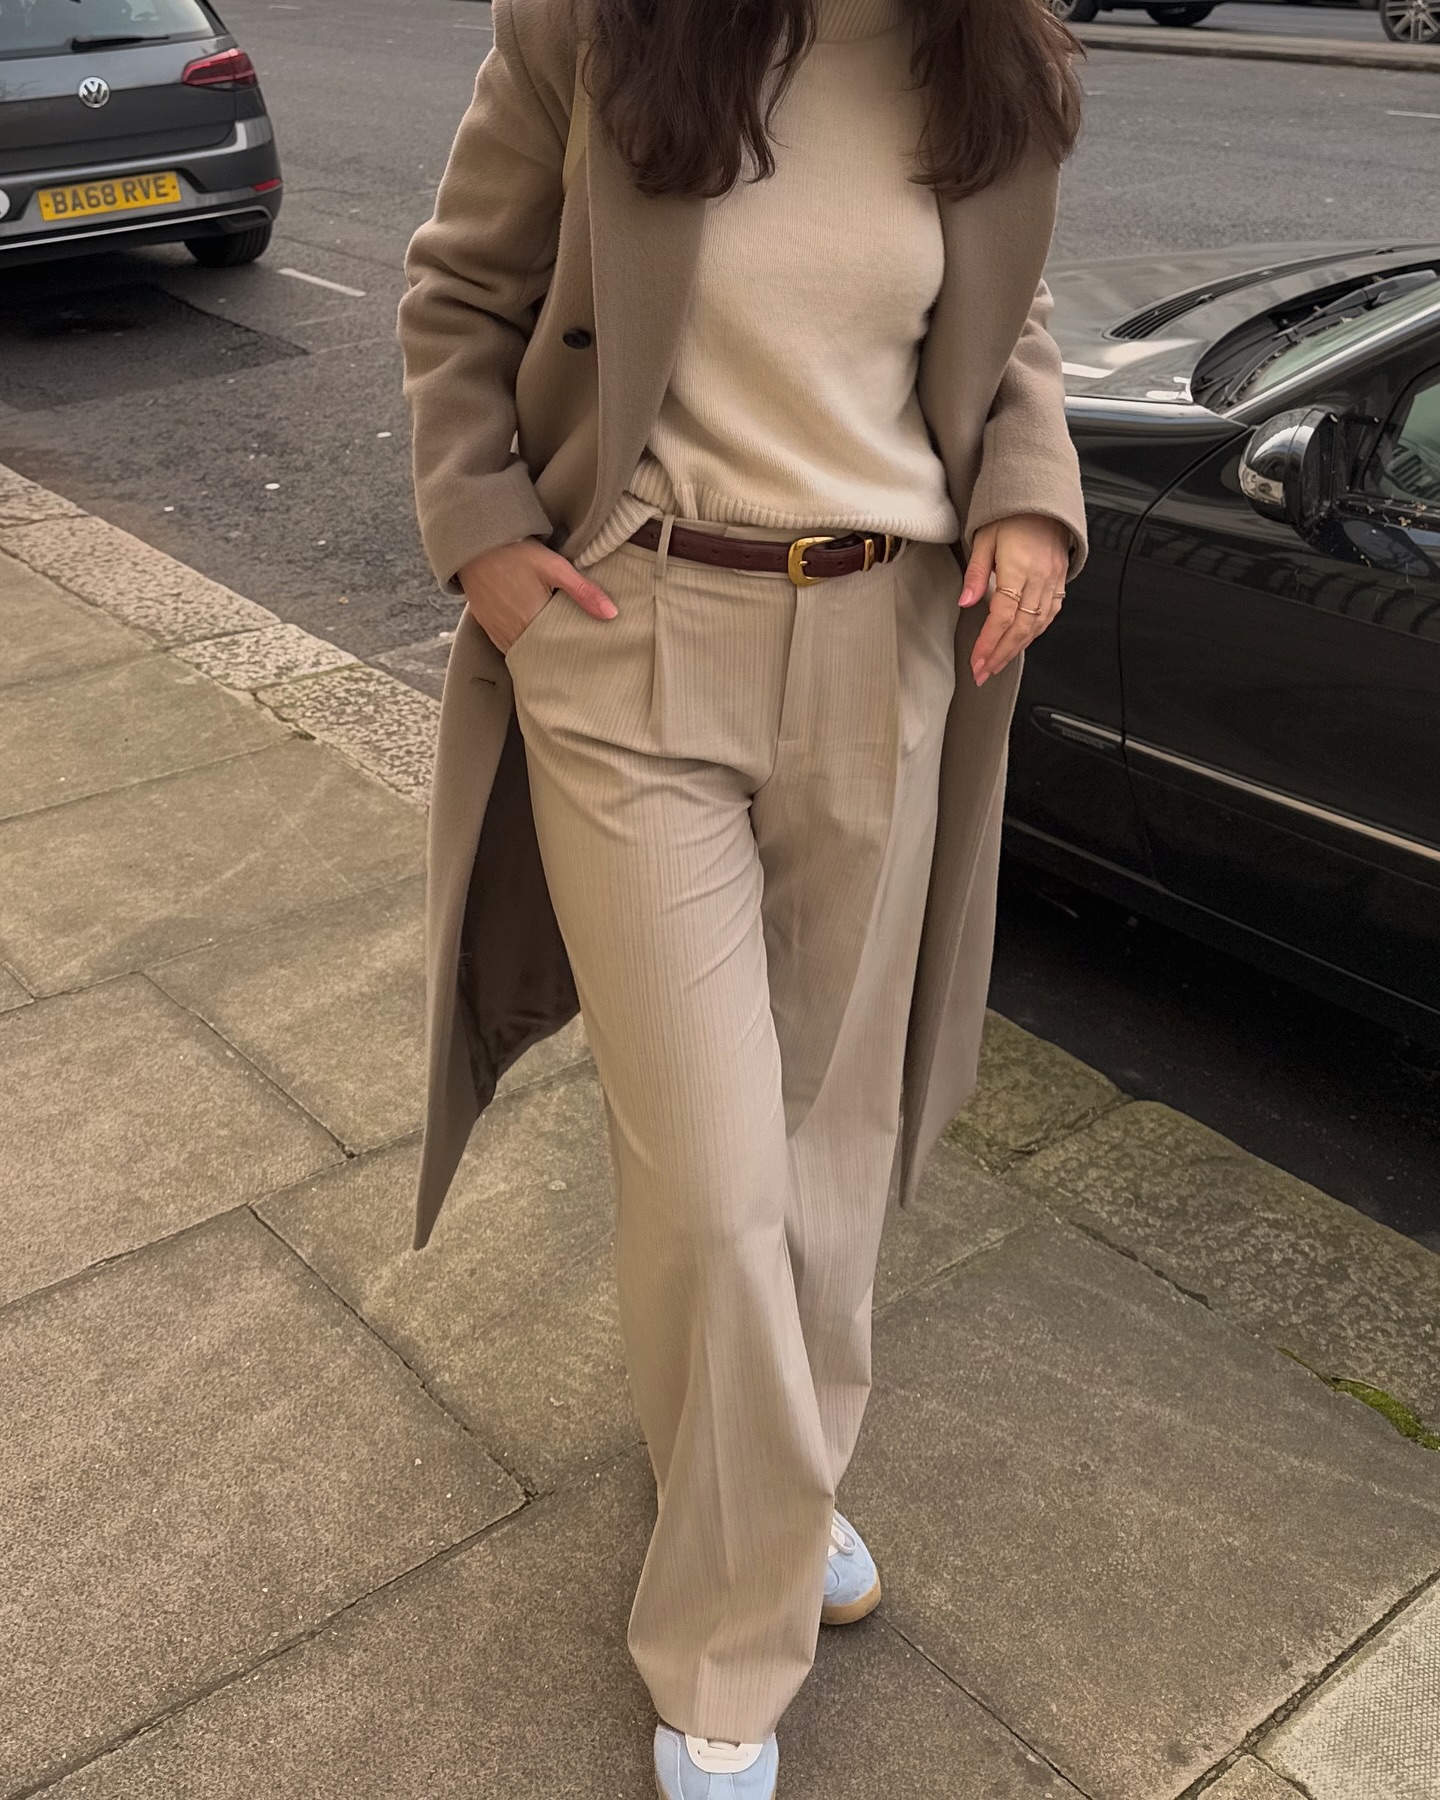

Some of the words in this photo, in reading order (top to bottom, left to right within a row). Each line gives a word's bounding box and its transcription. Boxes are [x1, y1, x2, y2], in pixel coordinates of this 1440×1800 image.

[80, 78, 109, 107] VW
[51, 183, 117, 214] BA68
[122, 176, 169, 203] RVE
